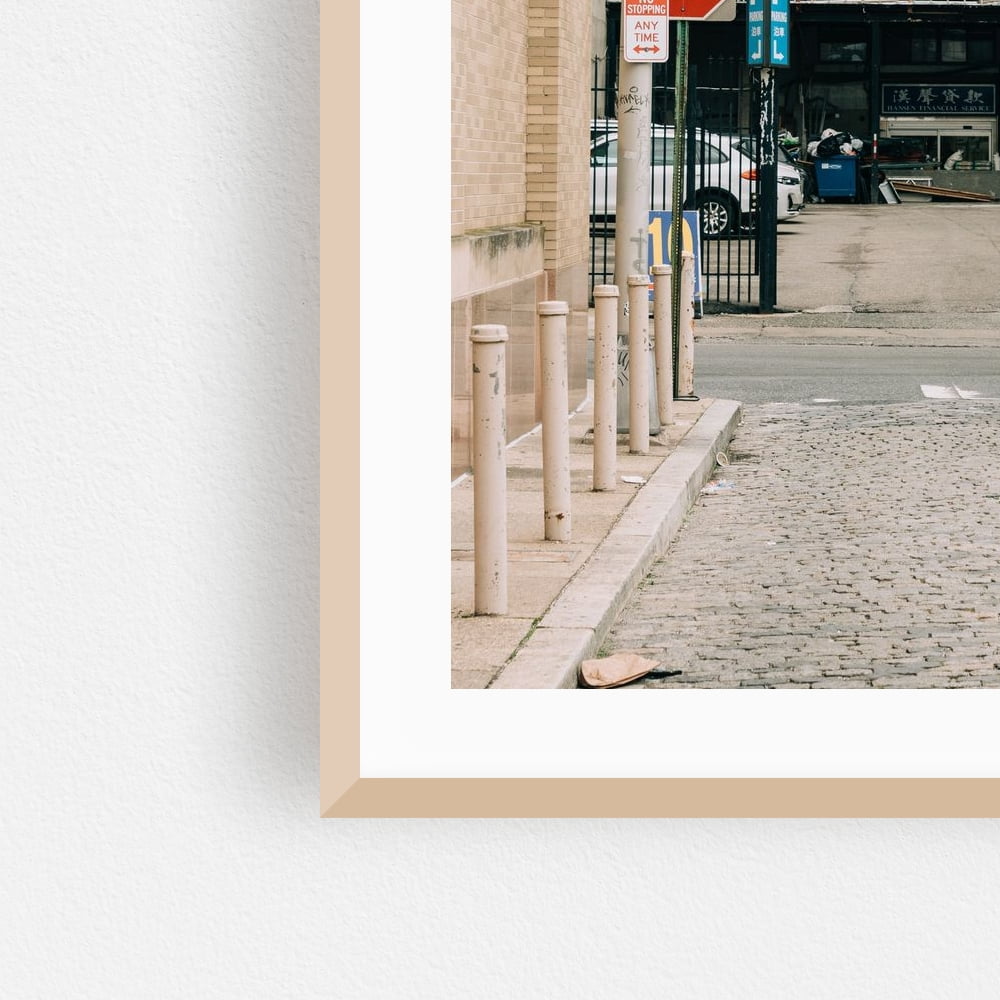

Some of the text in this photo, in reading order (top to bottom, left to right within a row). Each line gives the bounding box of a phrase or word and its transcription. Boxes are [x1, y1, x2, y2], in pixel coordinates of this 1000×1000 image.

[627, 4, 666, 14] STOPPING
[634, 21, 659, 30] ANY
[634, 33, 659, 43] TIME
